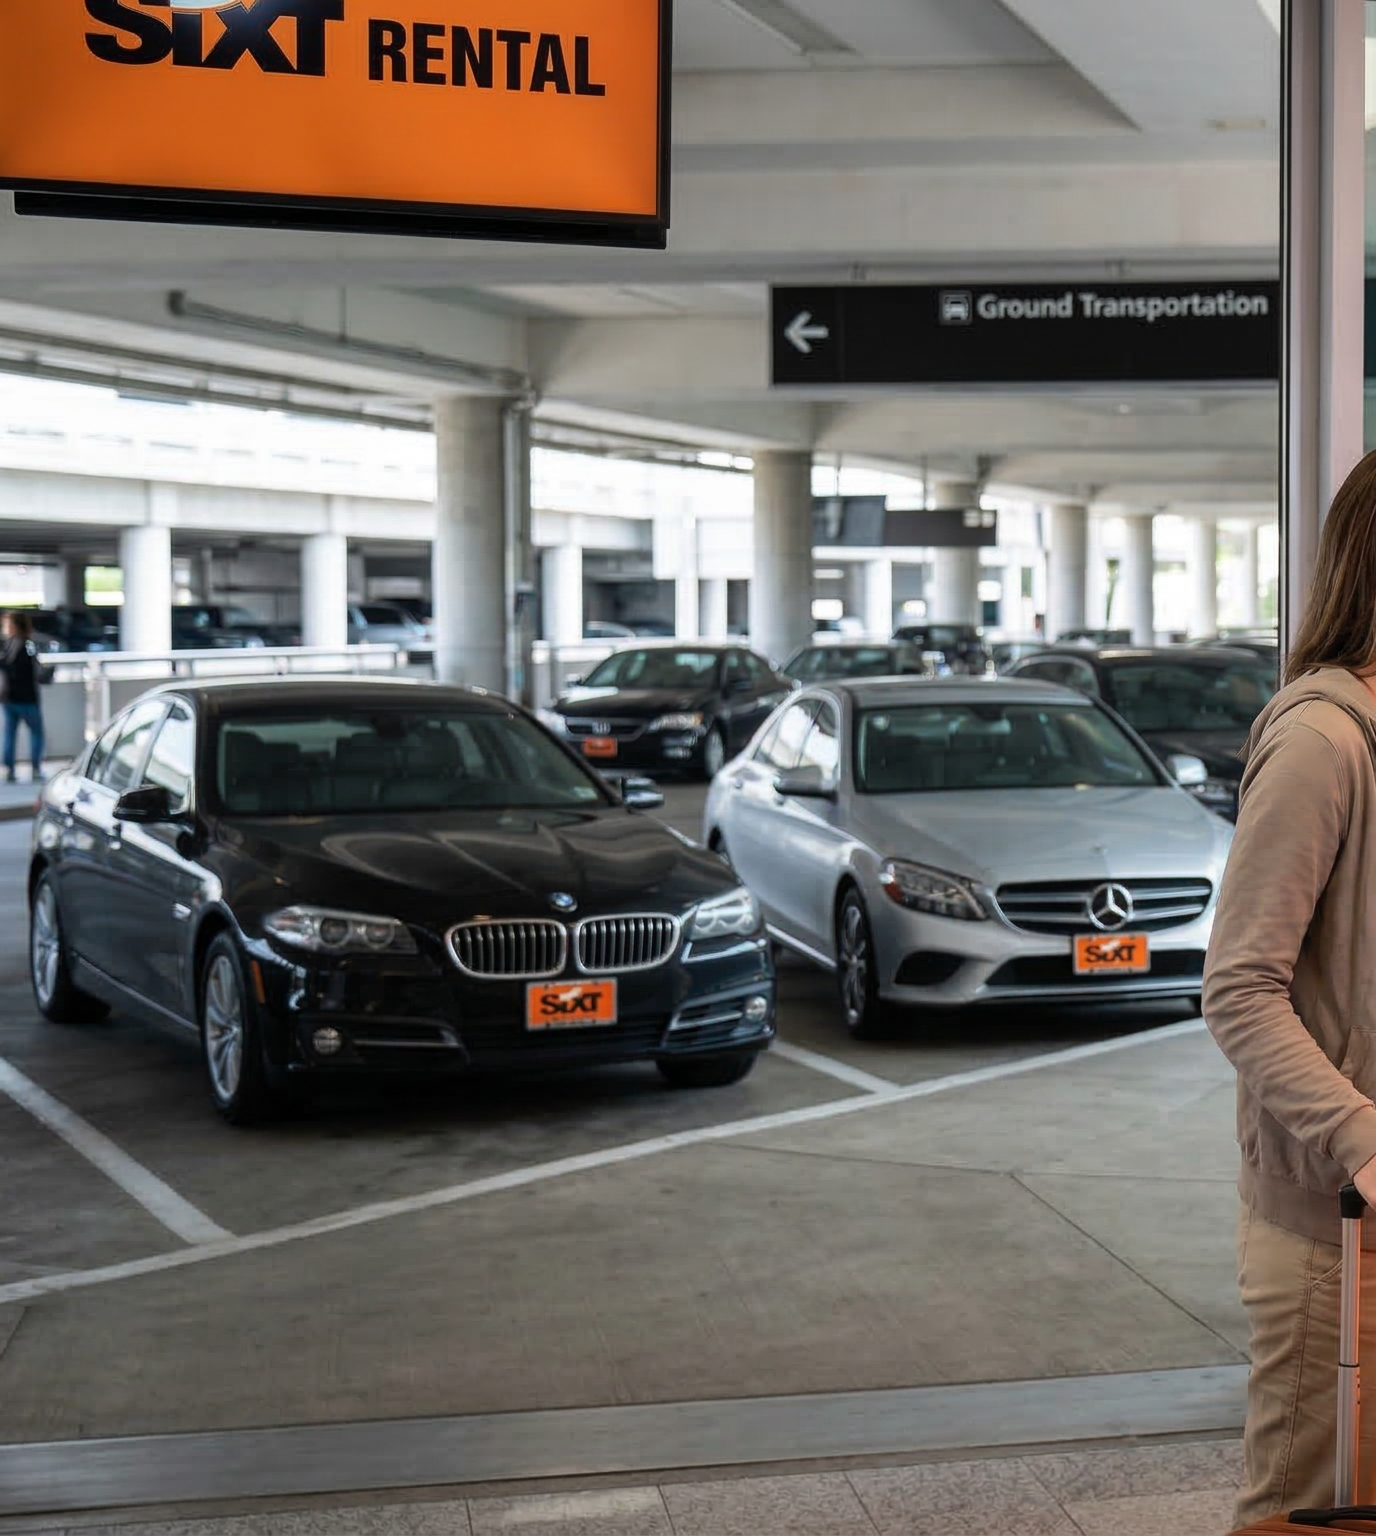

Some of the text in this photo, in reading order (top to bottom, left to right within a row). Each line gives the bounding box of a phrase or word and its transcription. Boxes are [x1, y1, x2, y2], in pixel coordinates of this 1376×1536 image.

[85, 0, 606, 97] SIXT RENTAL
[976, 290, 1269, 323] Ground Transportation
[1085, 939, 1137, 963] SIXT
[539, 986, 602, 1016] SIXT
